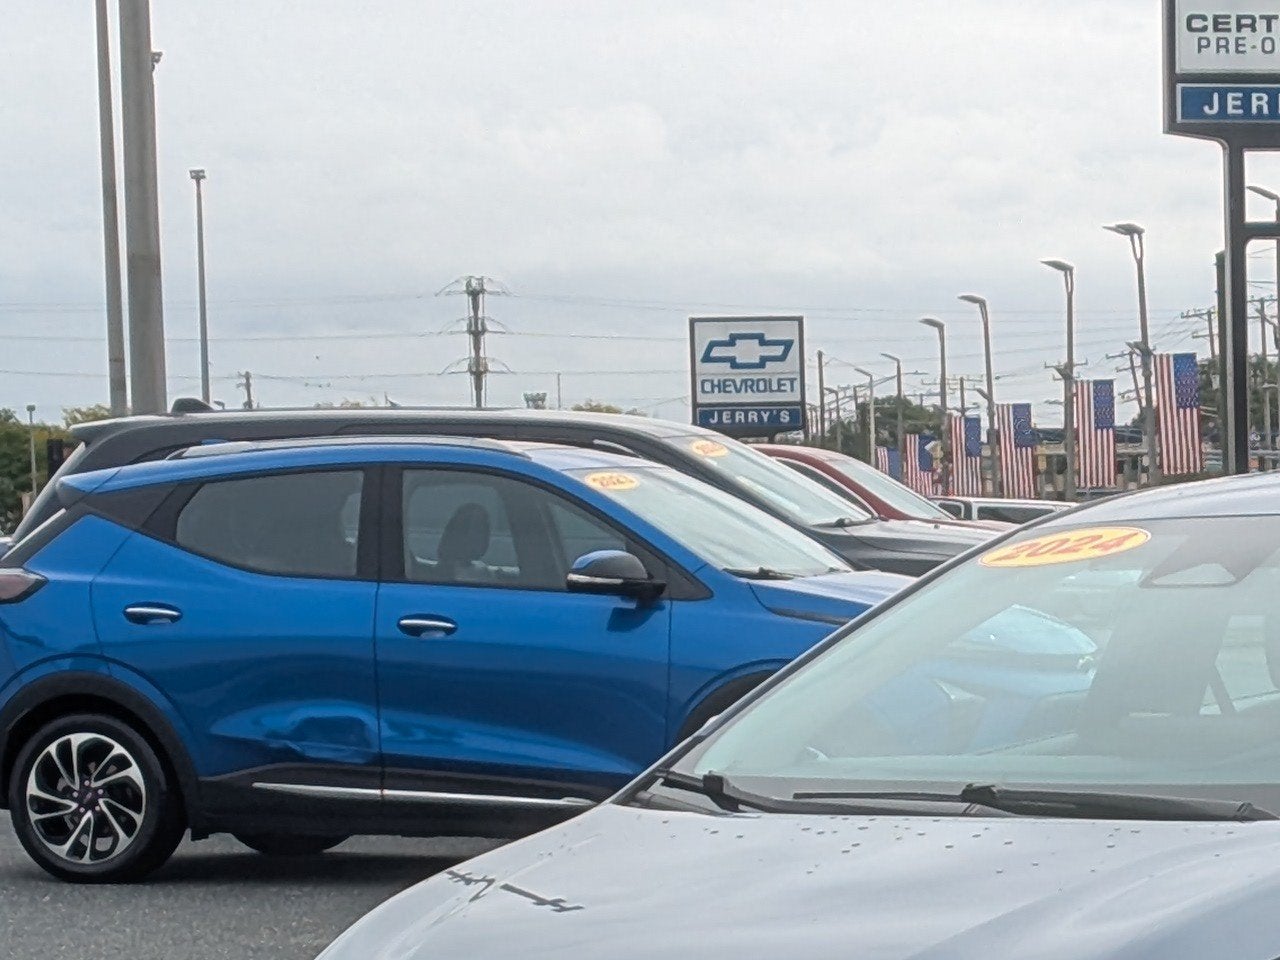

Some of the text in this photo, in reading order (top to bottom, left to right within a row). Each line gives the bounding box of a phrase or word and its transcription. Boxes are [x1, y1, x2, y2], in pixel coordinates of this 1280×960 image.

[700, 377, 798, 394] CHEVROLET
[709, 410, 791, 424] JERRY'S
[990, 532, 1139, 562] 2024
